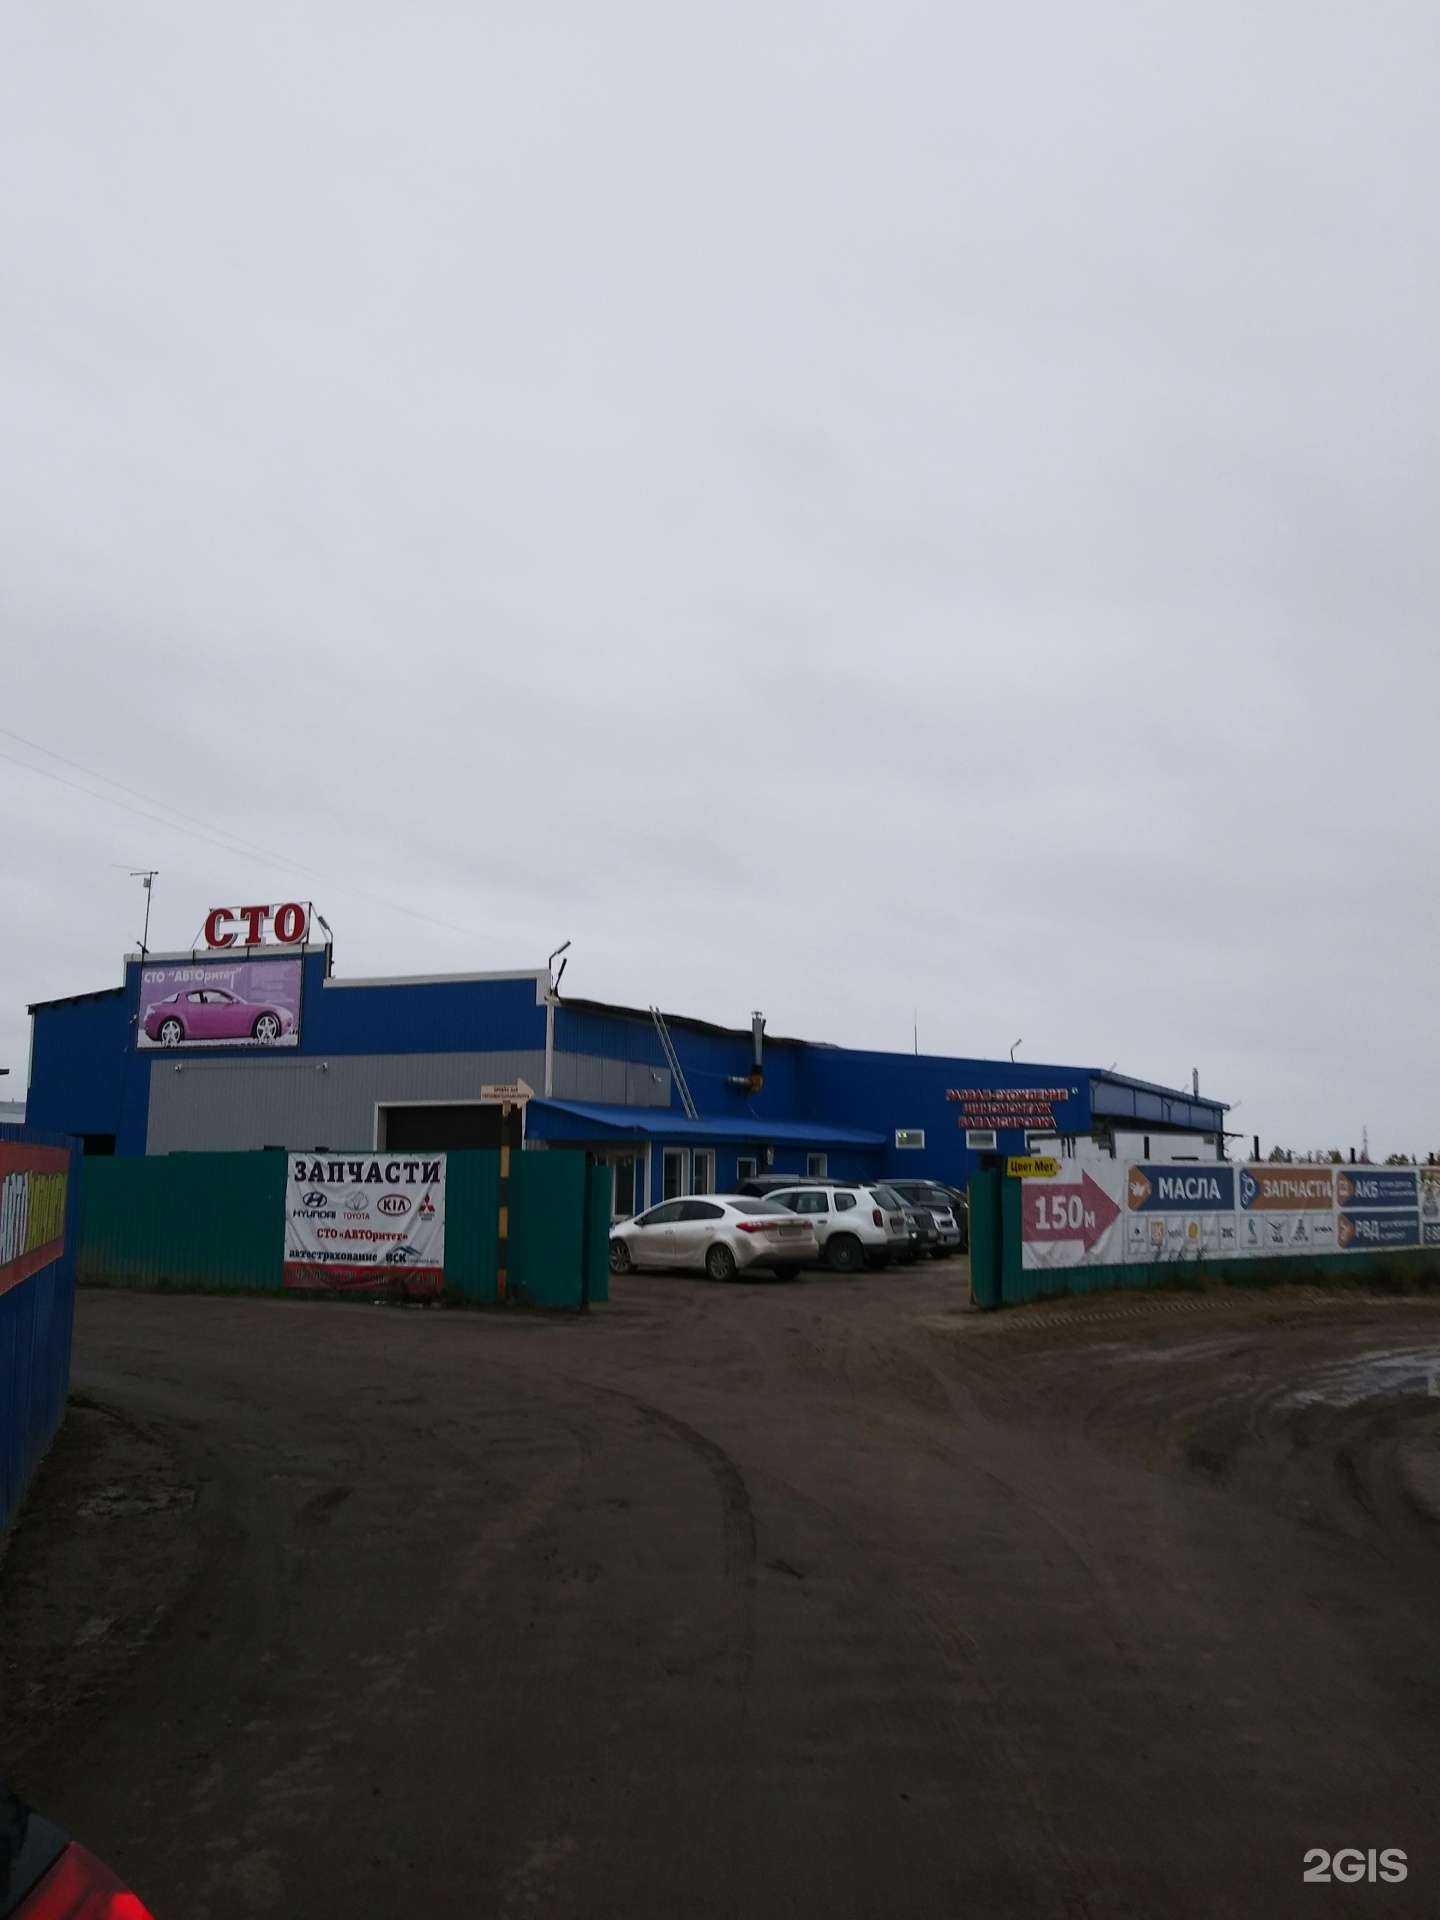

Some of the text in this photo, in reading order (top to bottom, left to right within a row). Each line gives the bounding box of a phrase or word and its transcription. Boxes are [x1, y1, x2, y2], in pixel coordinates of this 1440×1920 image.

[204, 903, 307, 948] СТО
[143, 970, 165, 984] СТО
[294, 1160, 441, 1184] ЗАПЧАСТИ
[1158, 1177, 1221, 1200] МАСЛА
[383, 1199, 406, 1211] KIA
[293, 1208, 336, 1219] HYUNDAI
[343, 1211, 370, 1220] TOYOTA
[317, 1228, 338, 1239] СТО
[289, 1249, 378, 1263] автострахование
